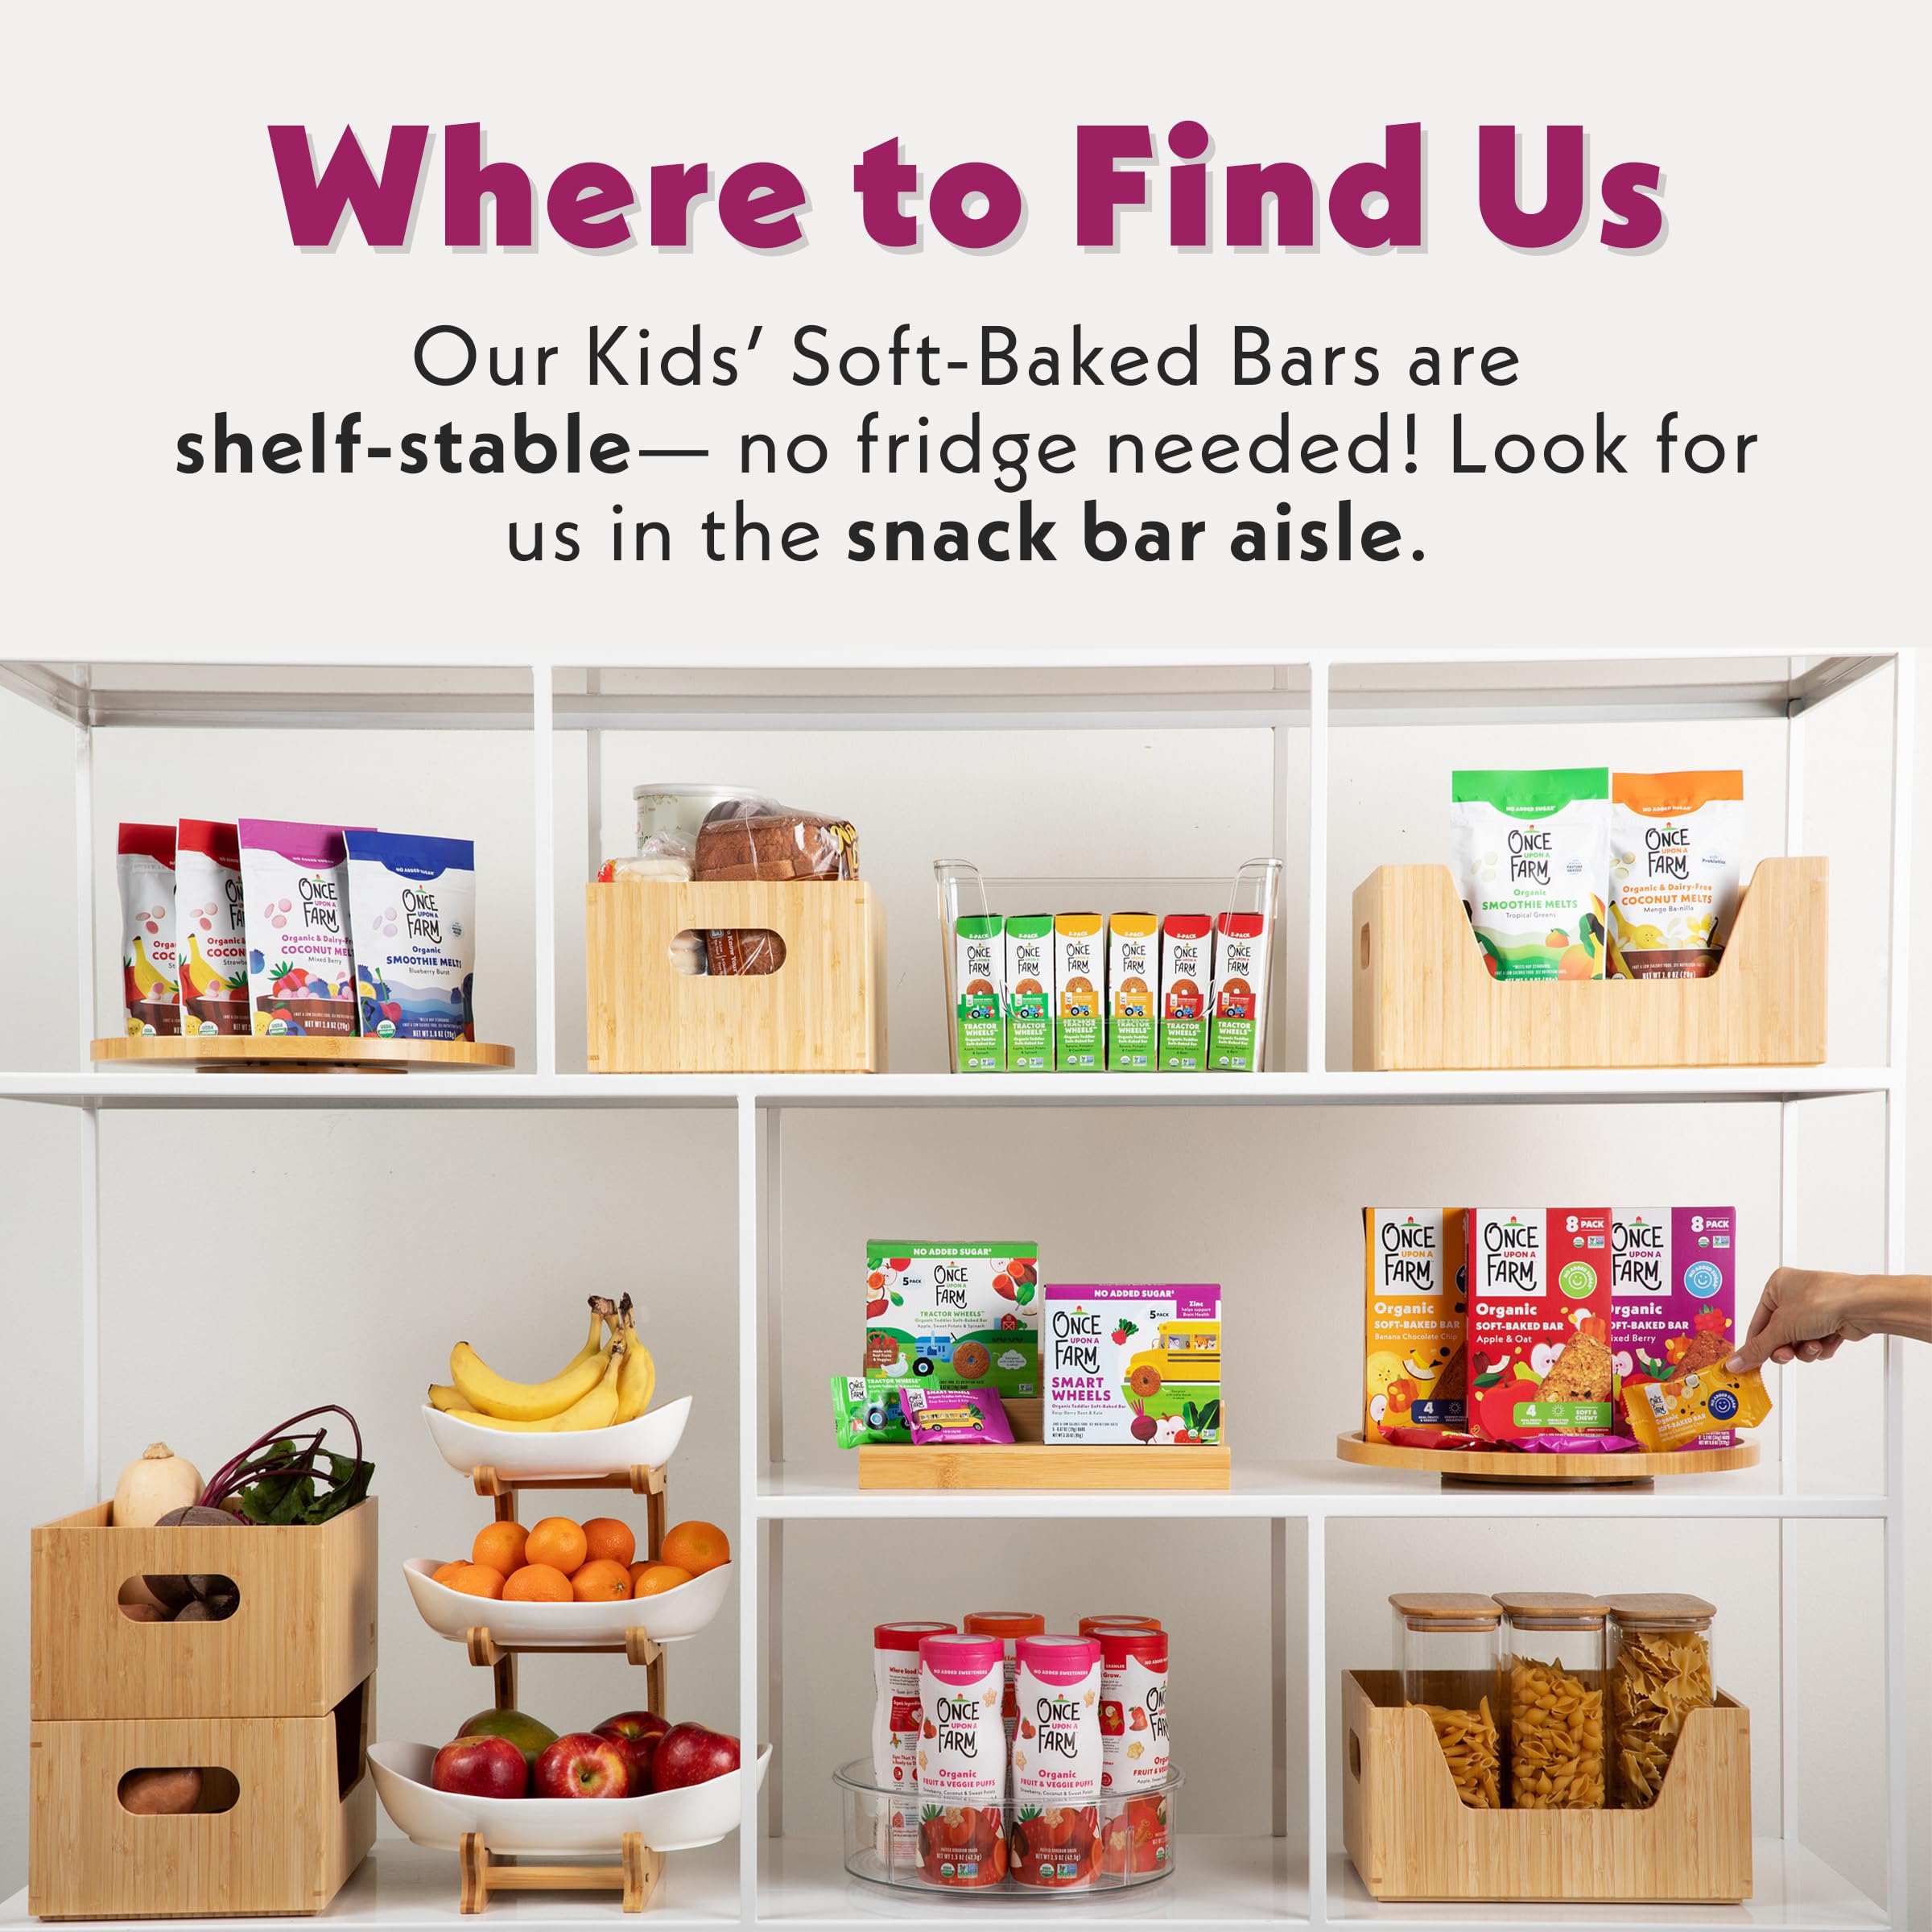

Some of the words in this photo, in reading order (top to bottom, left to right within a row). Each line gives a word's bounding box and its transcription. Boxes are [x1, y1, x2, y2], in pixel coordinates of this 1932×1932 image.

[1508, 830, 1552, 853] ONCE
[1645, 828, 1690, 850] ONCE
[1511, 855, 1550, 886] FARM
[1649, 851, 1689, 880] FARM
[299, 877, 337, 901] ONCE
[1513, 889, 1546, 898] Organic
[1623, 885, 1657, 894] Organic
[1668, 883, 1712, 892] Dairy-Free
[402, 889, 438, 912] ONCE
[1482, 901, 1542, 910] SMOOTHIE
[1545, 900, 1578, 908] MELTS
[1622, 895, 1677, 906] COCONUT
[1681, 894, 1712, 904] MELTS
[303, 902, 339, 933] FARM
[407, 913, 442, 943] FARM
[207, 937, 241, 947] Organic
[282, 935, 315, 943] Organic
[281, 945, 332, 955] COCONUT
[412, 946, 440, 954] Organic
[967, 946, 991, 960] ONCE
[1016, 945, 1040, 960] ONCE
[1066, 943, 1090, 957] ONCE
[1122, 943, 1146, 956] ONCE
[1174, 945, 1197, 959] ONCE
[1227, 944, 1251, 958] ONCE
[386, 956, 437, 966] SMOOTHIE
[968, 960, 991, 976] FARM
[1018, 959, 1040, 976] FARM
[1067, 957, 1090, 974] FARM
[1123, 957, 1146, 974] FARM
[1174, 960, 1196, 976] FARM
[1228, 958, 1249, 976] FARM
[409, 967, 435, 975] Blueberry
[1566, 1216, 1579, 1232] 8
[1580, 1220, 1604, 1228] PACK
[1691, 1216, 1704, 1232] 8
[1706, 1220, 1729, 1228] PACK
[1381, 1223, 1435, 1252] ONCE
[1484, 1222, 1539, 1252] ONCE
[1612, 1223, 1664, 1252] ONCE
[934, 1265, 968, 1284] ONCE
[1385, 1253, 1434, 1290] FARM
[1488, 1253, 1537, 1291] FARM
[1612, 1253, 1662, 1291] FARM
[902, 1277, 909, 1286] 5
[936, 1285, 967, 1309] FARM
[1150, 1310, 1156, 1319] 5
[1374, 1302, 1435, 1317] Organic
[1476, 1302, 1538, 1318] Organic
[1611, 1302, 1662, 1318] rganic
[1053, 1311, 1102, 1338] ONCE
[1374, 1321, 1437, 1329] SOFT-BAKED
[1439, 1321, 1459, 1329] BAR
[1476, 1322, 1540, 1331] SOFT-BAKED
[1542, 1322, 1563, 1331] BAR
[1668, 1321, 1689, 1330] BAR
[1440, 1333, 1458, 1341] Chip
[1476, 1335, 1503, 1344] Apple
[1632, 1335, 1656, 1343] Berry
[1055, 1340, 1100, 1374] FARM
[1051, 1377, 1104, 1388] SMART
[1051, 1389, 1111, 1401] WHEELS
[1423, 1402, 1434, 1414] 4
[1526, 1404, 1536, 1417] 4
[936, 1697, 979, 1723] ONCE
[1037, 1698, 1080, 1724] ONCE
[939, 1724, 978, 1758] FARM
[1038, 1724, 1078, 1758] FARM
[939, 1769, 976, 1779] Organic
[1038, 1769, 1076, 1780] Organic
[923, 1777, 939, 1786] FRUIT
[976, 1779, 996, 1787] PUFFS
[1020, 1777, 1038, 1786] FRUIT
[1075, 1779, 1094, 1787] PUFFS
